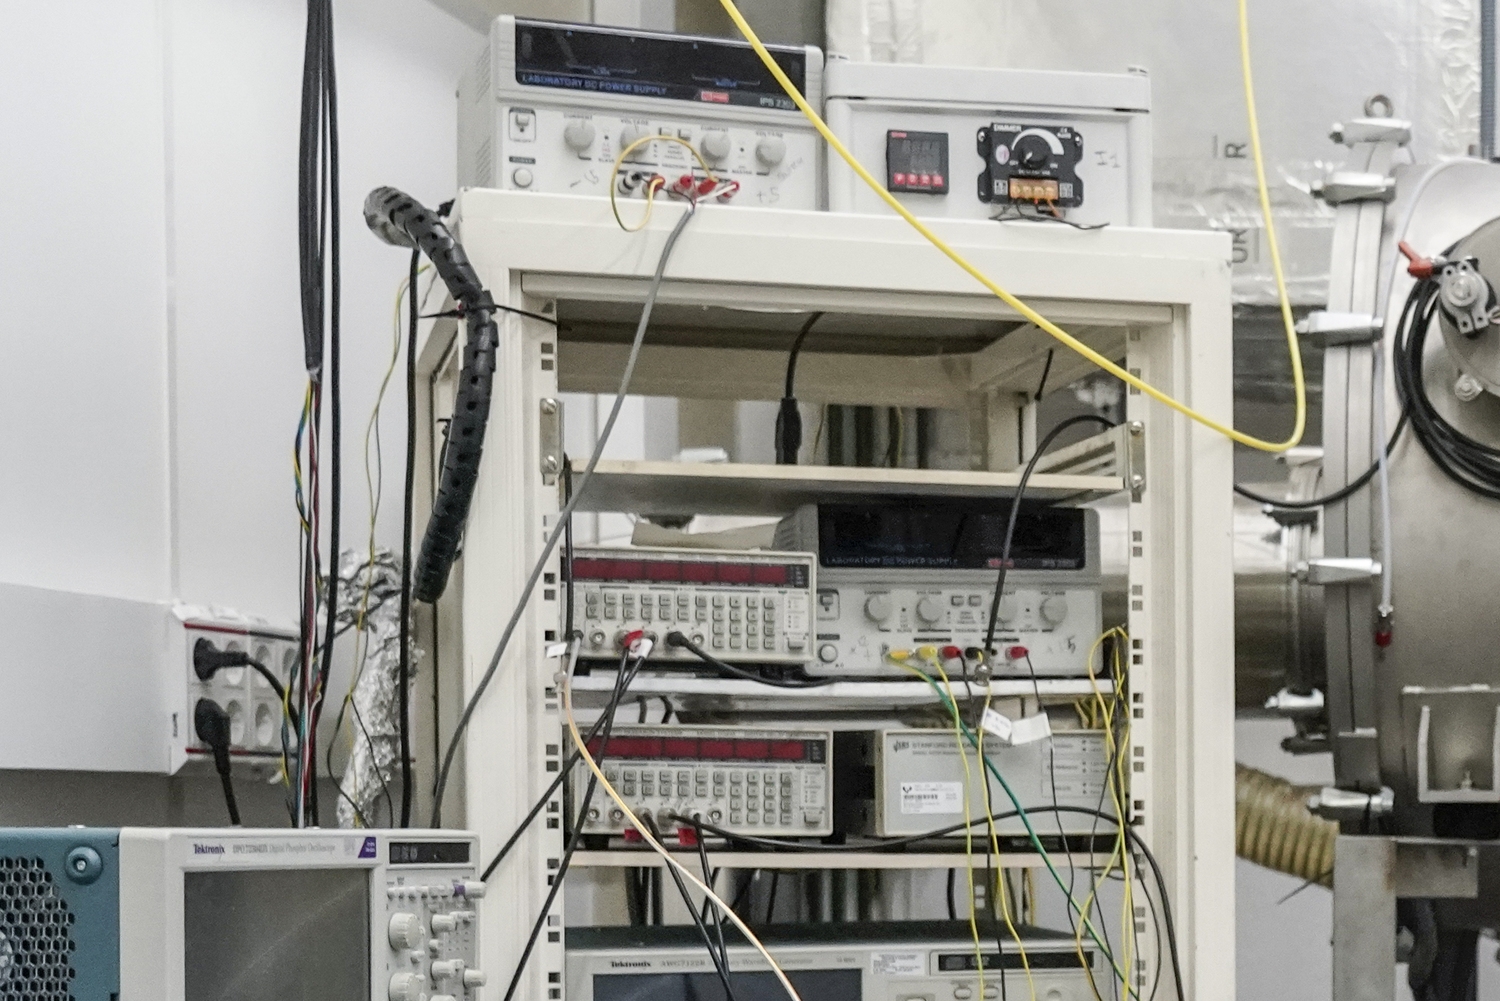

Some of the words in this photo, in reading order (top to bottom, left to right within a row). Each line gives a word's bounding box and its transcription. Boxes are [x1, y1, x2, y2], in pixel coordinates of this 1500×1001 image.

[522, 74, 583, 87] LABORATORY
[599, 82, 632, 91] POWER
[633, 85, 668, 95] SUPPLY
[1224, 143, 1248, 158] R
[193, 844, 225, 855] Tektronix
[610, 960, 651, 969] Tektronix
